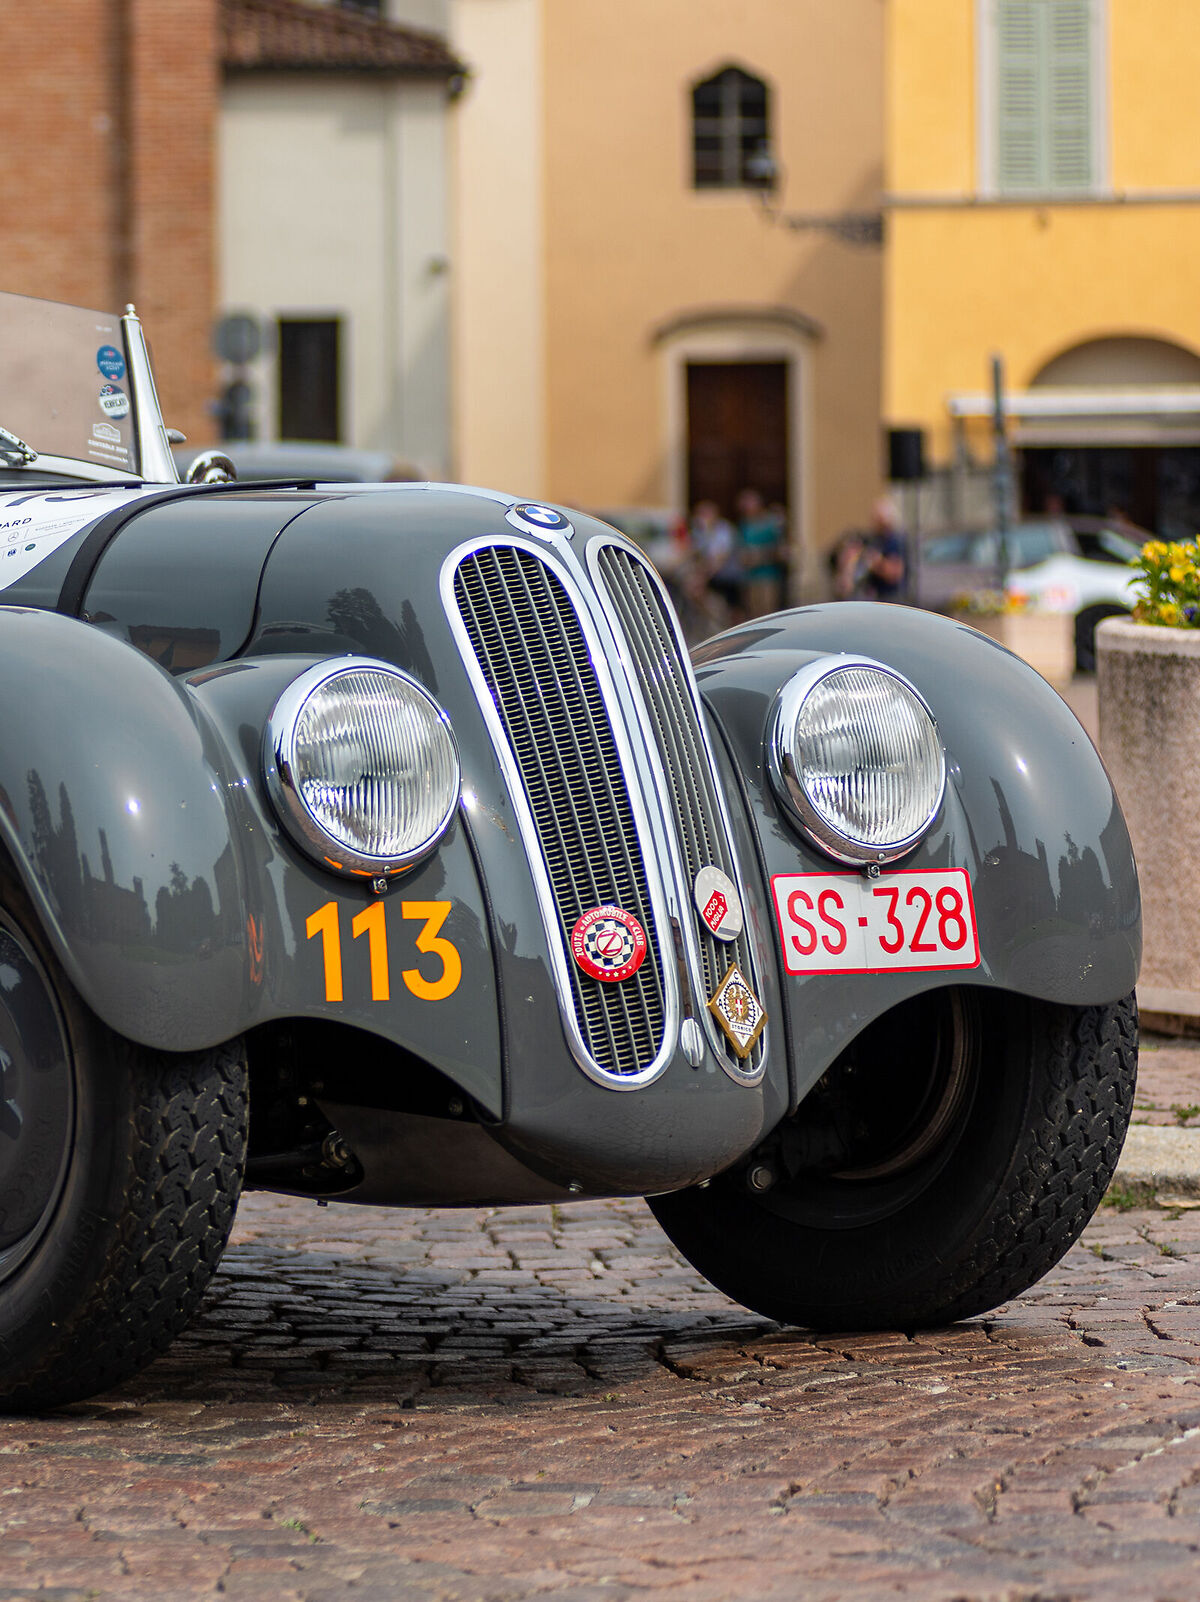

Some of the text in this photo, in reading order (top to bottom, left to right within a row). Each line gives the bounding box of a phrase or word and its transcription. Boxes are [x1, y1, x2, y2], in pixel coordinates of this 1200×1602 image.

[705, 898, 719, 918] 1000
[710, 905, 725, 928] MIGLIA
[574, 907, 644, 958] ZOUTE AUTOMOBILE CLUB
[305, 901, 462, 1002] 113
